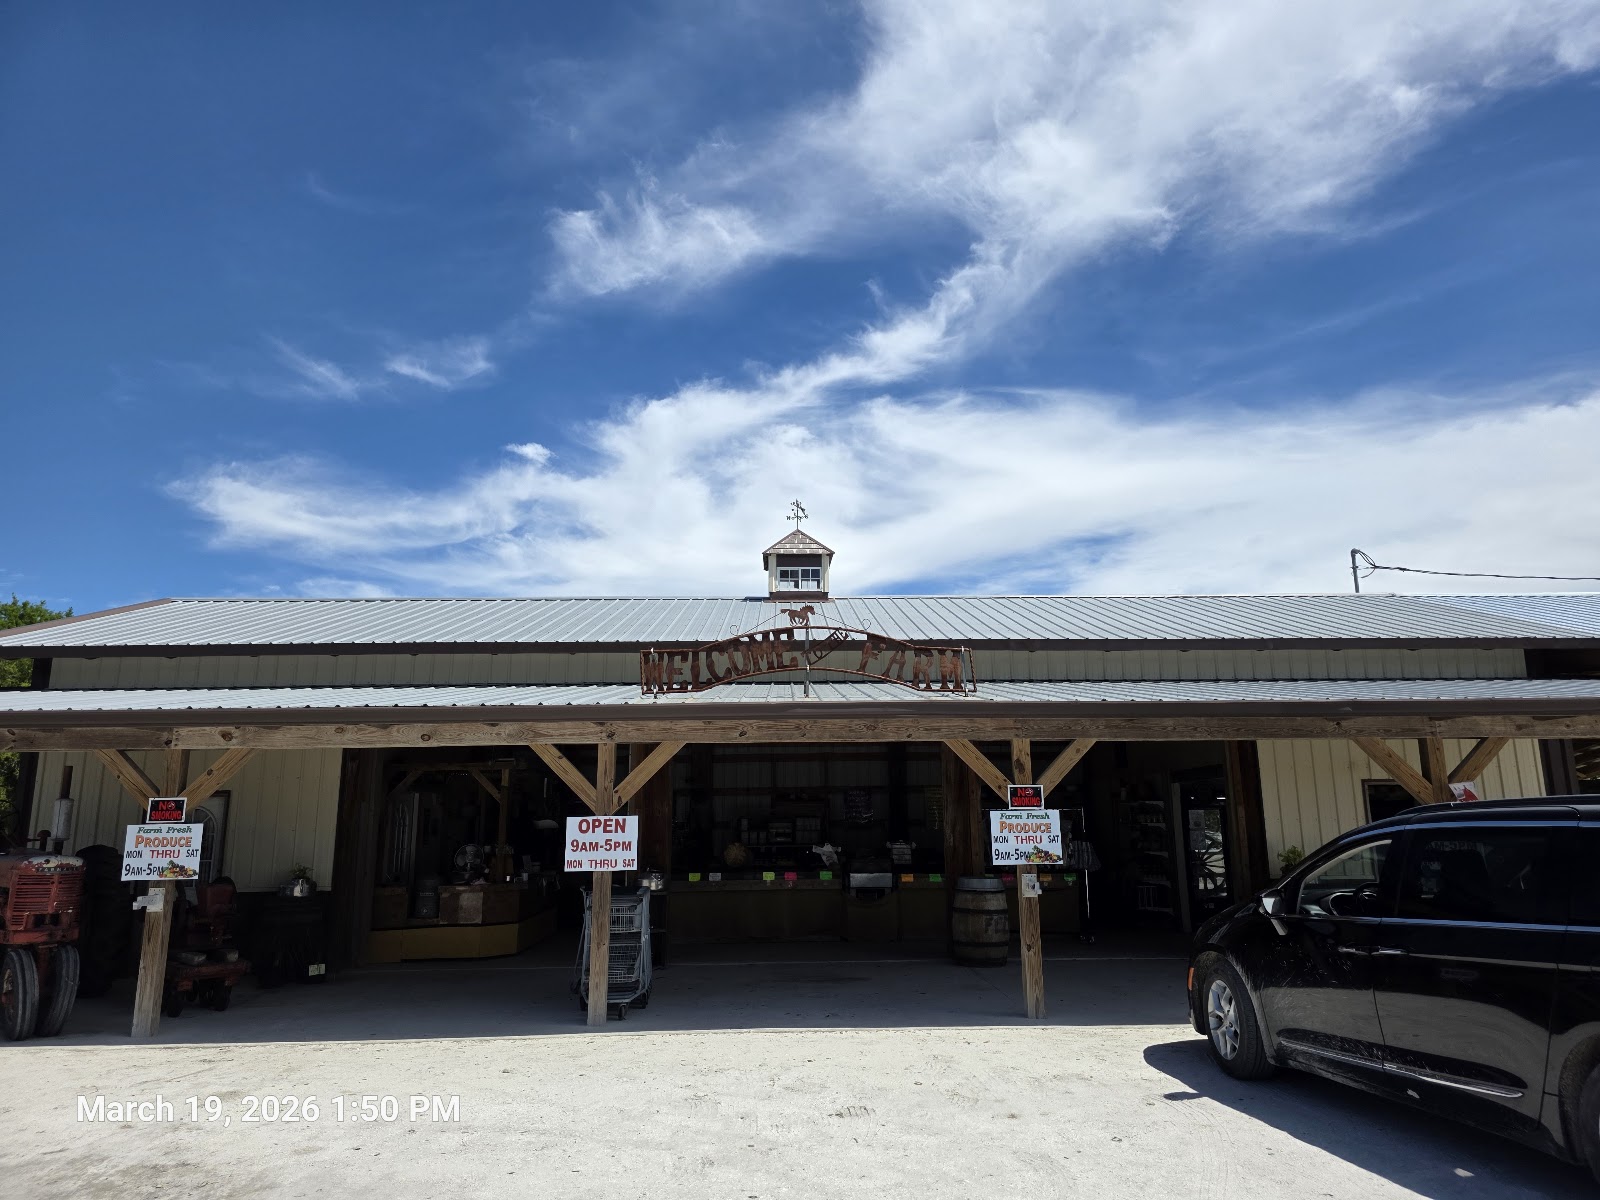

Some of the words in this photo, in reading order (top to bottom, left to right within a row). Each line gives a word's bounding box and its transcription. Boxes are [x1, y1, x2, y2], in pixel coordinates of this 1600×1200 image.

[643, 629, 799, 691] WELCOME
[857, 632, 963, 690] FARM
[1018, 788, 1034, 797] NO
[158, 801, 176, 811] NO
[1012, 797, 1041, 806] SMOKING
[151, 811, 182, 820] SMOKING
[999, 812, 1023, 820] Farm
[1026, 812, 1050, 820] Fresh
[136, 826, 163, 834] Farm
[165, 825, 192, 834] Fresh
[578, 818, 627, 834] OPEN
[999, 821, 1052, 834] PRODUCE
[135, 835, 193, 848] PRODUCE
[993, 835, 1009, 844] MON
[1014, 835, 1043, 844] THRU
[1047, 835, 1060, 843] SAT
[570, 839, 632, 852] 9AM-5PM
[125, 850, 143, 859] MON
[150, 849, 181, 859] THRU
[185, 849, 199, 858] SAT
[566, 859, 583, 869] MON
[588, 859, 618, 869] THRU
[622, 859, 636, 868] SAT
